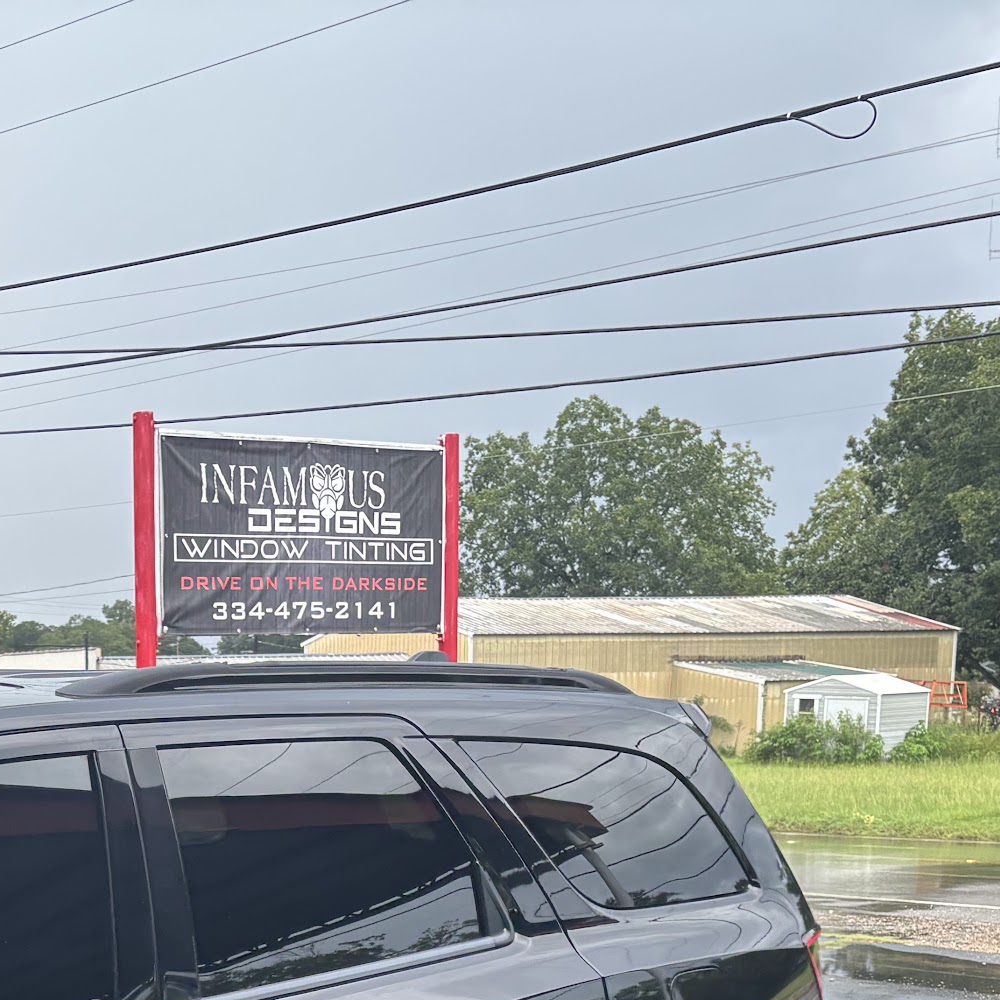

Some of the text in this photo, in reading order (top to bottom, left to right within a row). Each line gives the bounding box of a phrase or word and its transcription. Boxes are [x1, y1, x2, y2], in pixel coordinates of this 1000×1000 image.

[200, 462, 386, 510] INFAMUS
[248, 507, 401, 535] DESIGNS
[182, 537, 426, 562] WINDOW TINTING
[181, 576, 427, 592] DRIVE ON THE DARKSIDE
[212, 600, 396, 621] 334-475-2141
